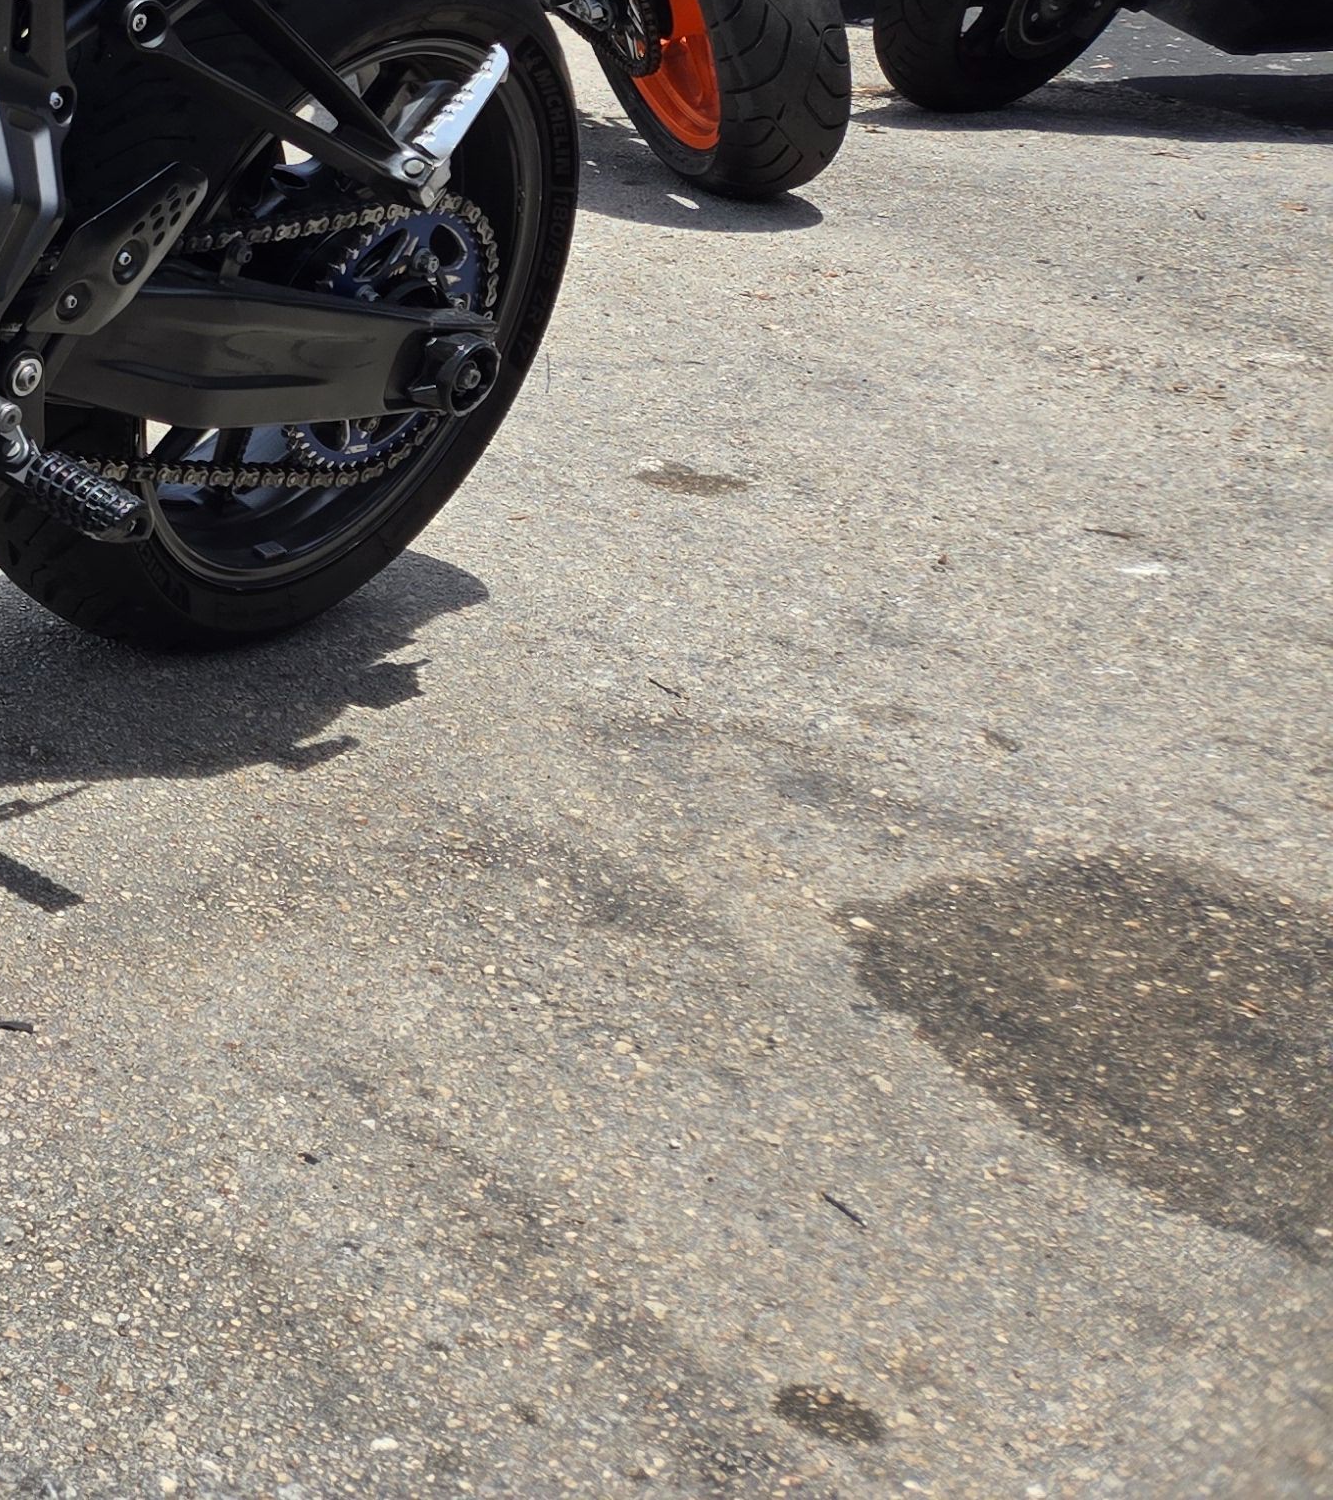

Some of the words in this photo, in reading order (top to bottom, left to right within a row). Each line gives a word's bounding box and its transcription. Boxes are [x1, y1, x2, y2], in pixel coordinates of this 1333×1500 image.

[532, 68, 570, 175] MICHELIN
[541, 195, 569, 281] 180/55
[526, 290, 547, 324] ZR
